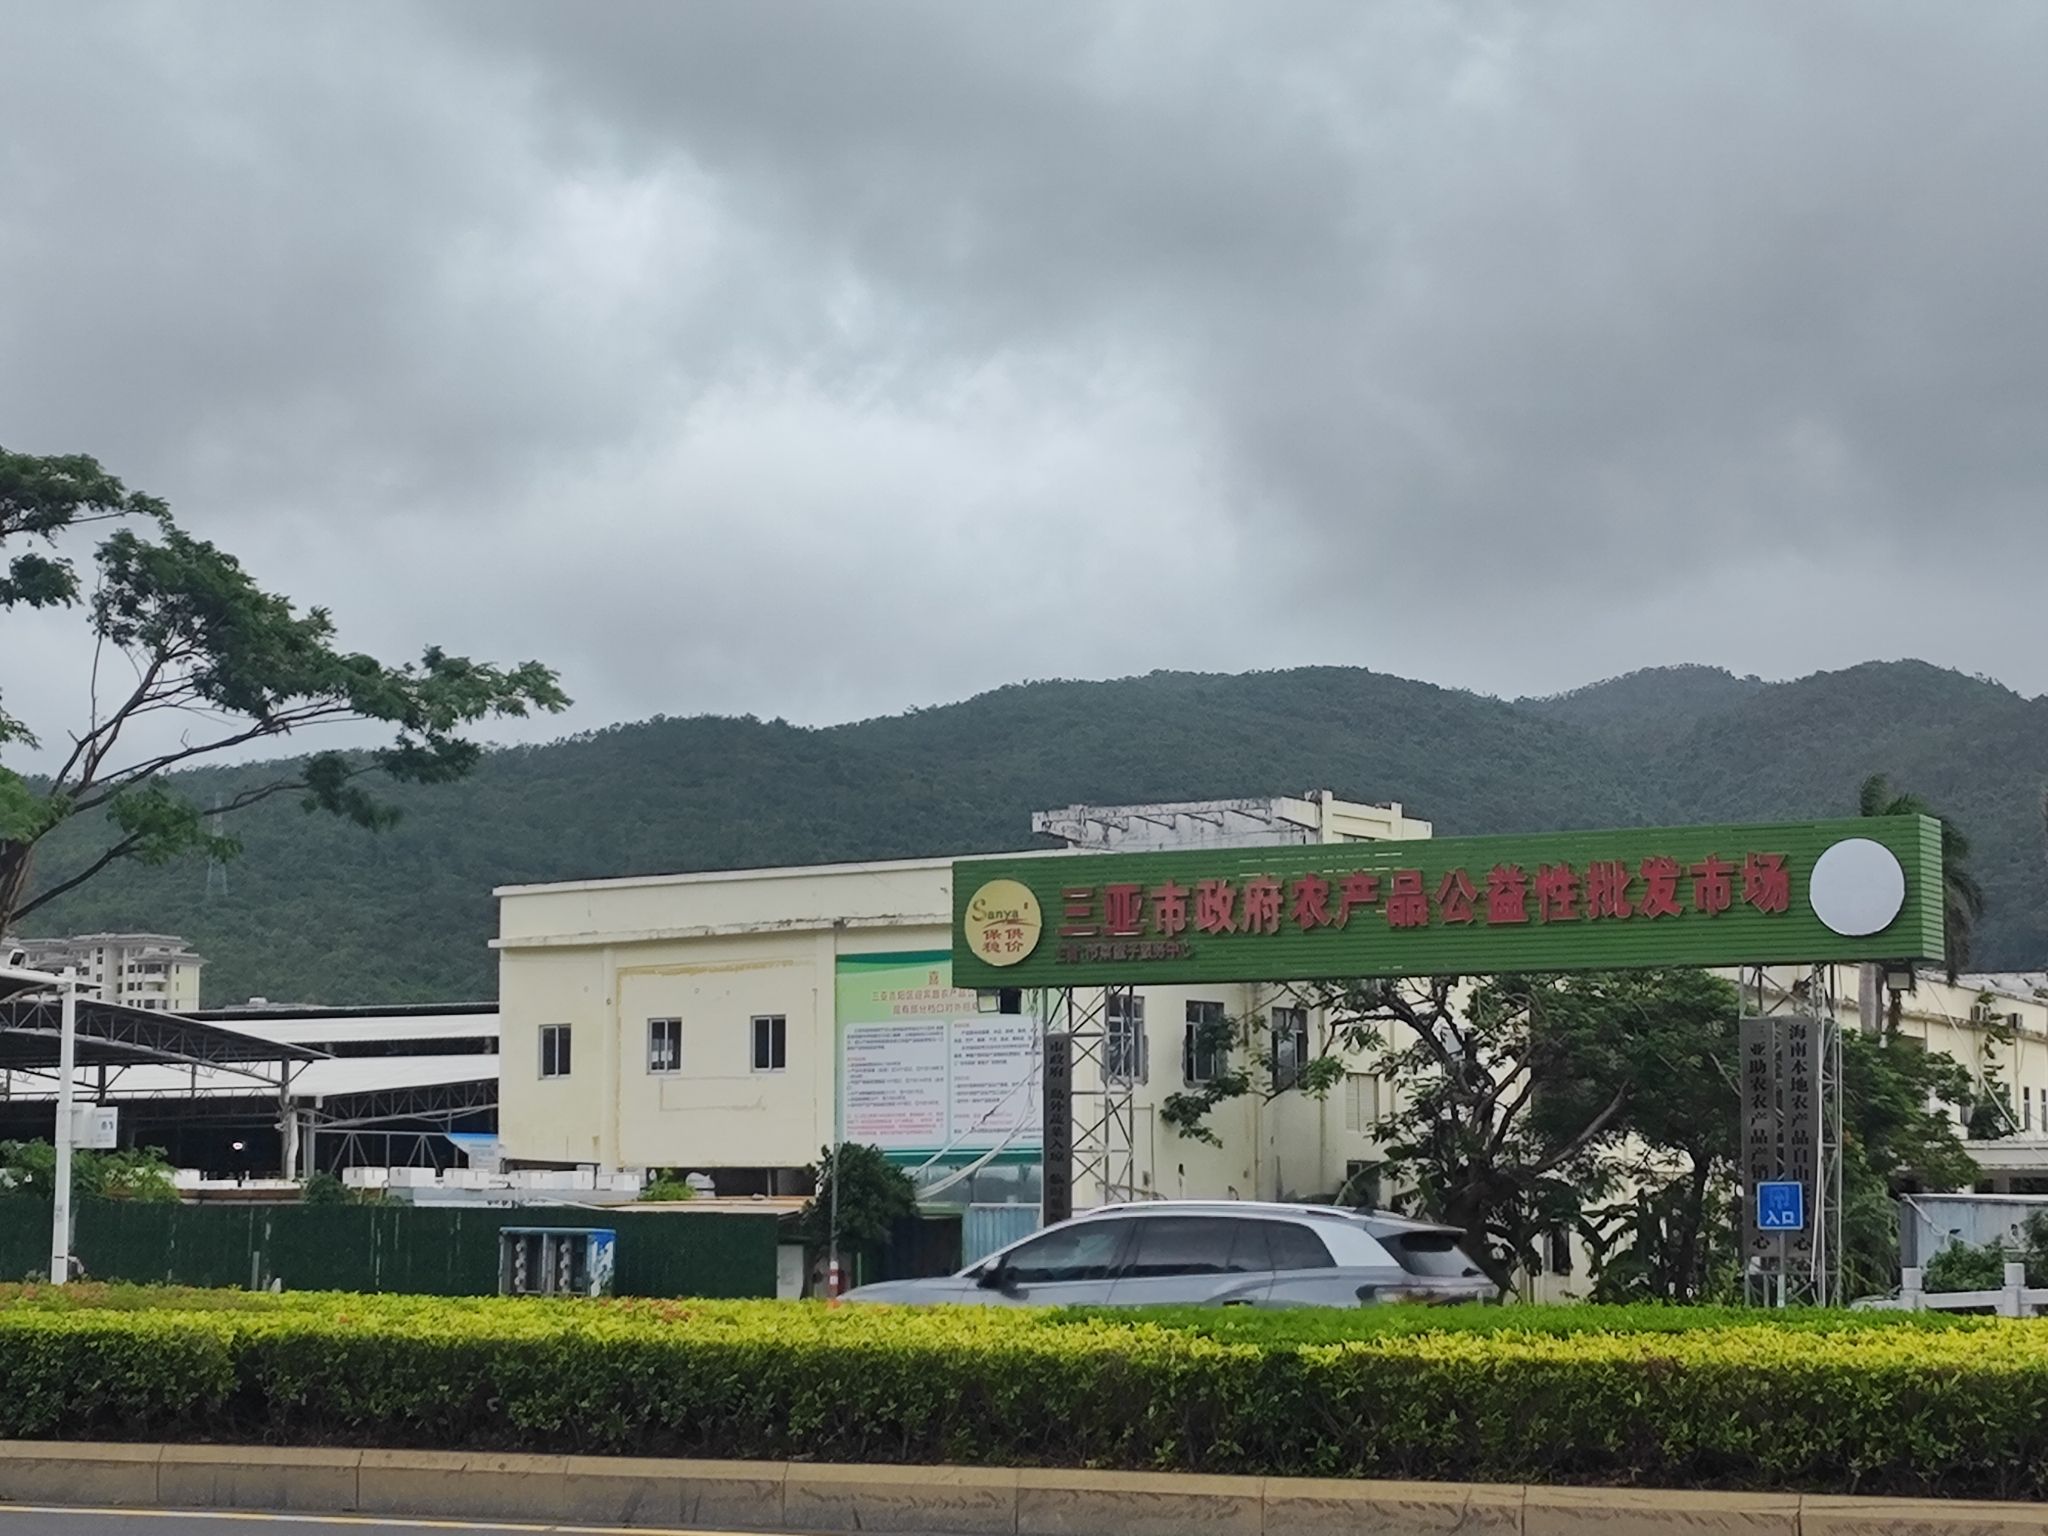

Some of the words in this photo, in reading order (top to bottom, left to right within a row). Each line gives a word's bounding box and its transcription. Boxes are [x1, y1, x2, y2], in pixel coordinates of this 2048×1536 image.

[1060, 852, 1790, 937] 三亚市政府农产品公益性批发市场
[972, 898, 1019, 922] Sanya
[983, 928, 1024, 940] 保供
[1766, 1210, 1795, 1225] 入口
